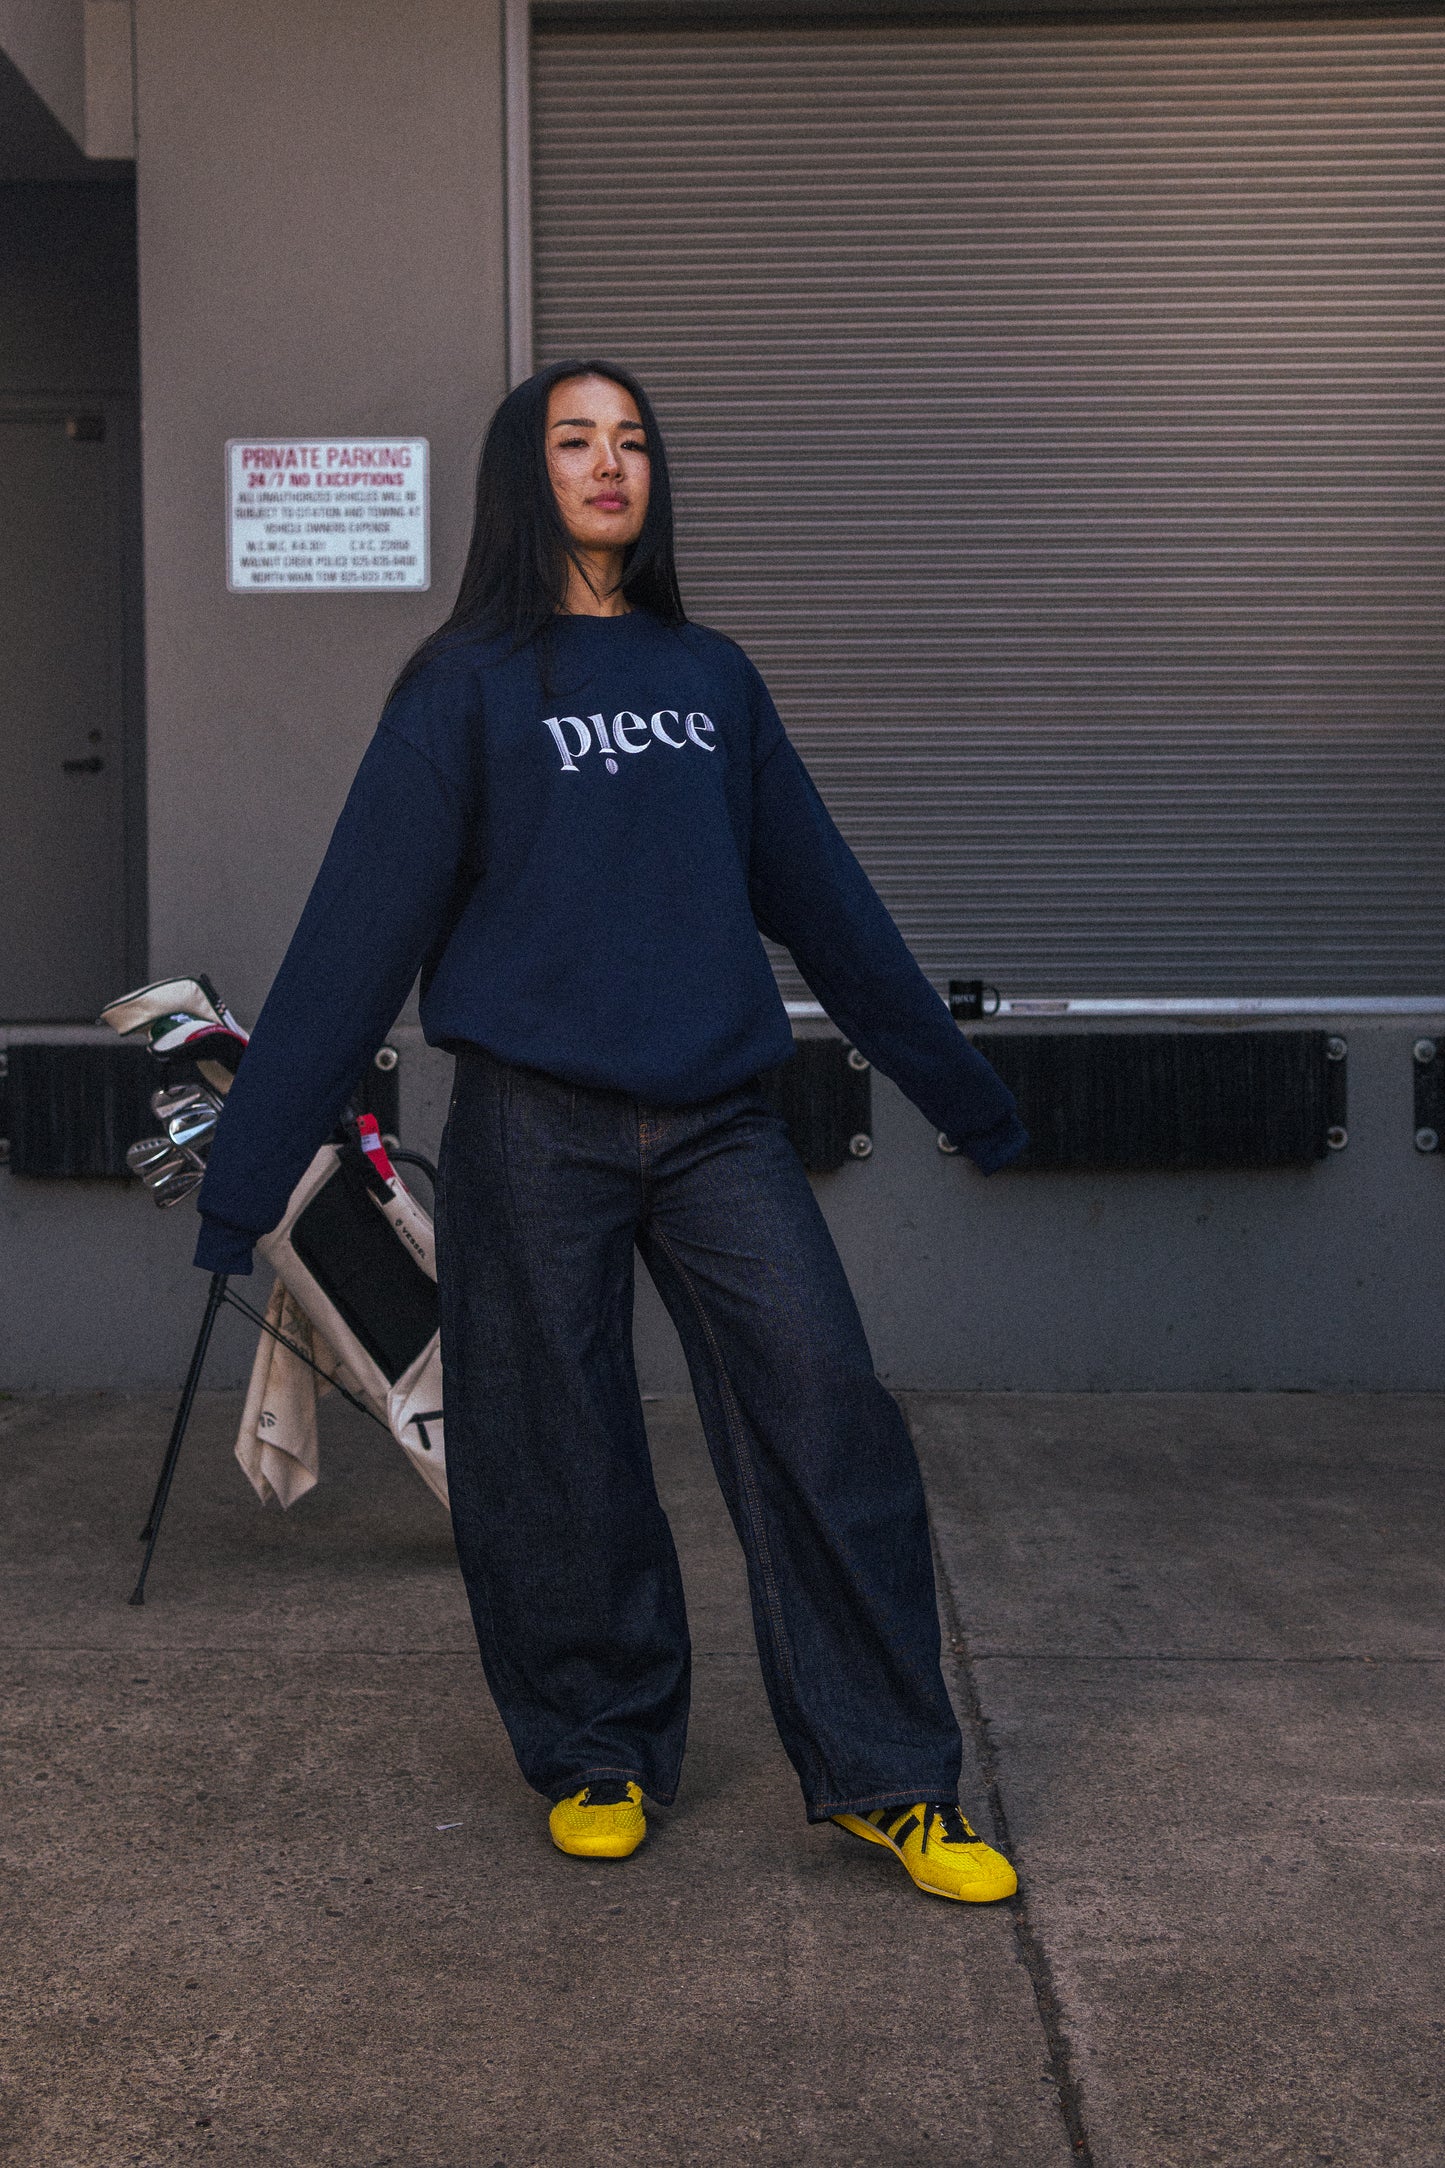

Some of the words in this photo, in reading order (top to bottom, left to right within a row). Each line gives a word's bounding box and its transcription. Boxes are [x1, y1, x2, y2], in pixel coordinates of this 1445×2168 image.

[242, 447, 320, 469] PRIVATE
[326, 447, 411, 468] PARKING
[290, 472, 310, 488] NO
[315, 472, 404, 487] EXCEPTIONS
[542, 709, 716, 775] piece
[402, 1227, 426, 1259] VESSEL
